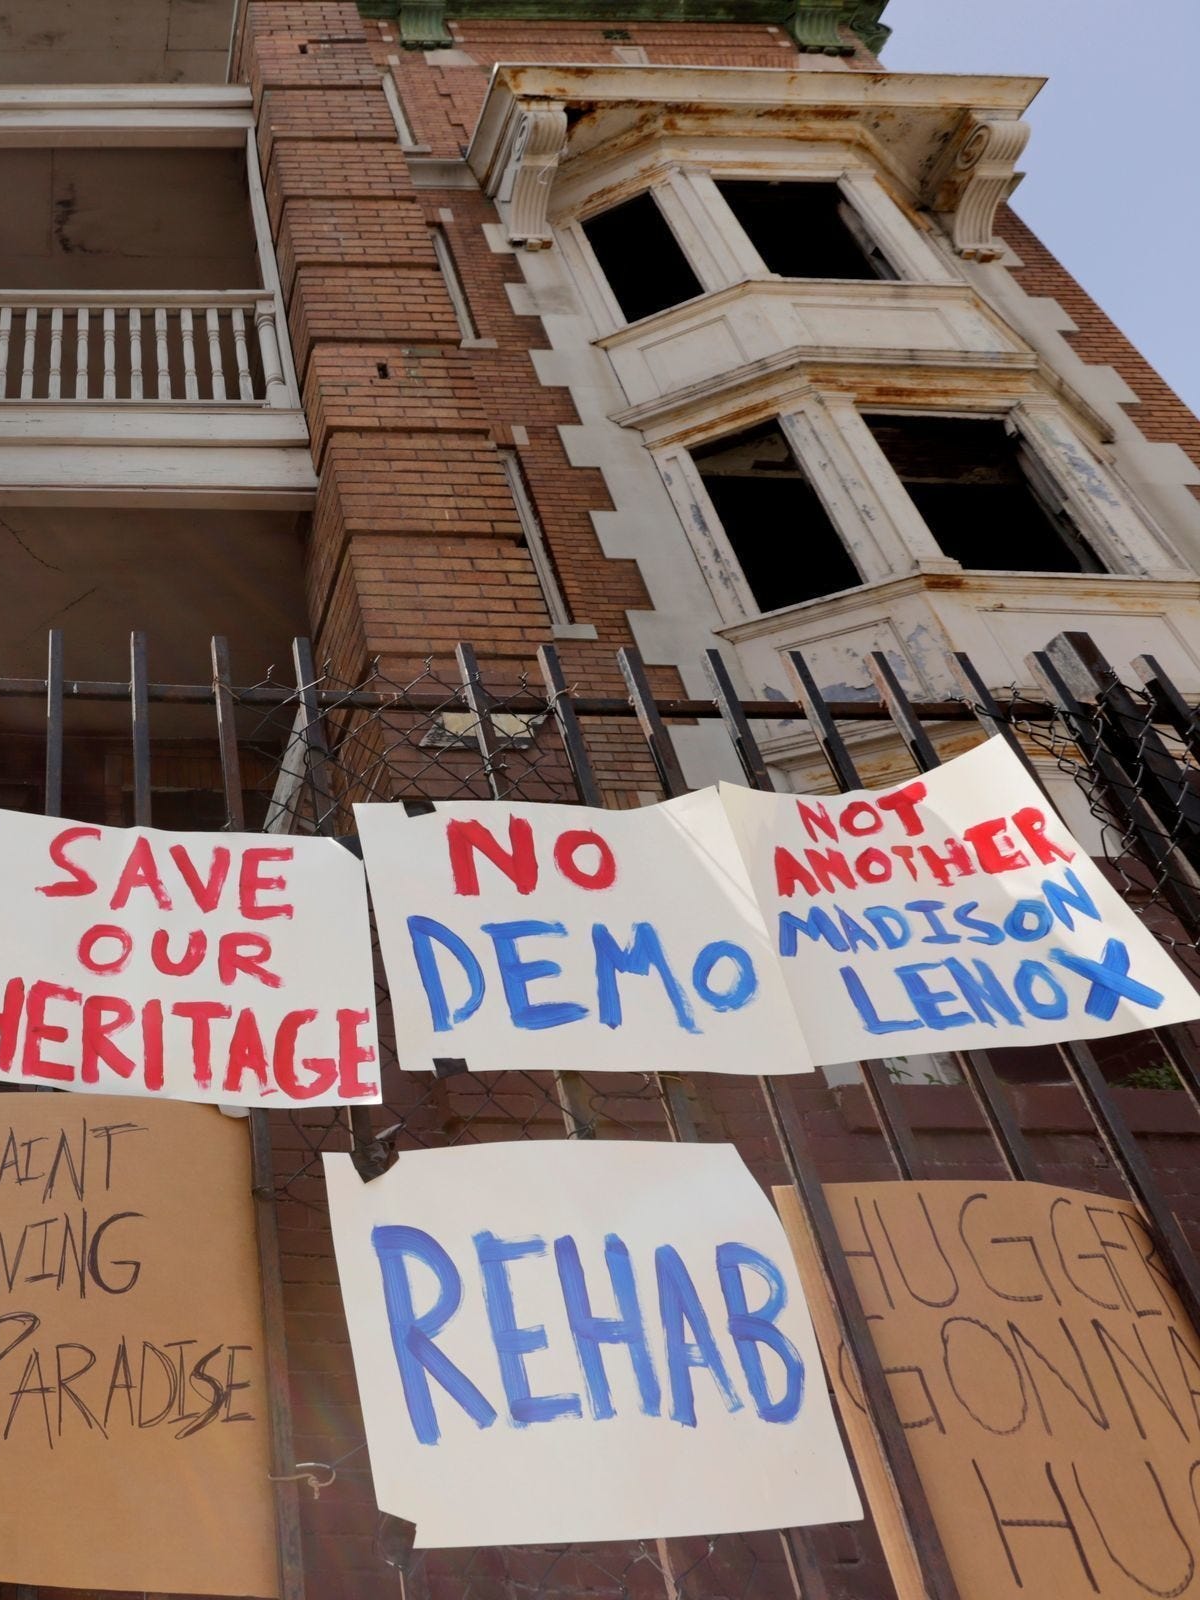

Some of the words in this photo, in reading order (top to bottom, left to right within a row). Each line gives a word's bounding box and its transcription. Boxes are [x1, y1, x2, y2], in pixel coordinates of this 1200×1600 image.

[447, 815, 618, 897] NO
[774, 806, 1078, 898] ANOTHER
[798, 780, 929, 843] NOT
[35, 826, 295, 921] SAVE
[778, 868, 1103, 958] MADISON
[77, 924, 283, 988] OUR
[406, 915, 759, 1035] DEMO
[839, 937, 1167, 1036] LENOX
[372, 1225, 806, 1446] REHAB
[971, 1458, 1200, 1600] HU
